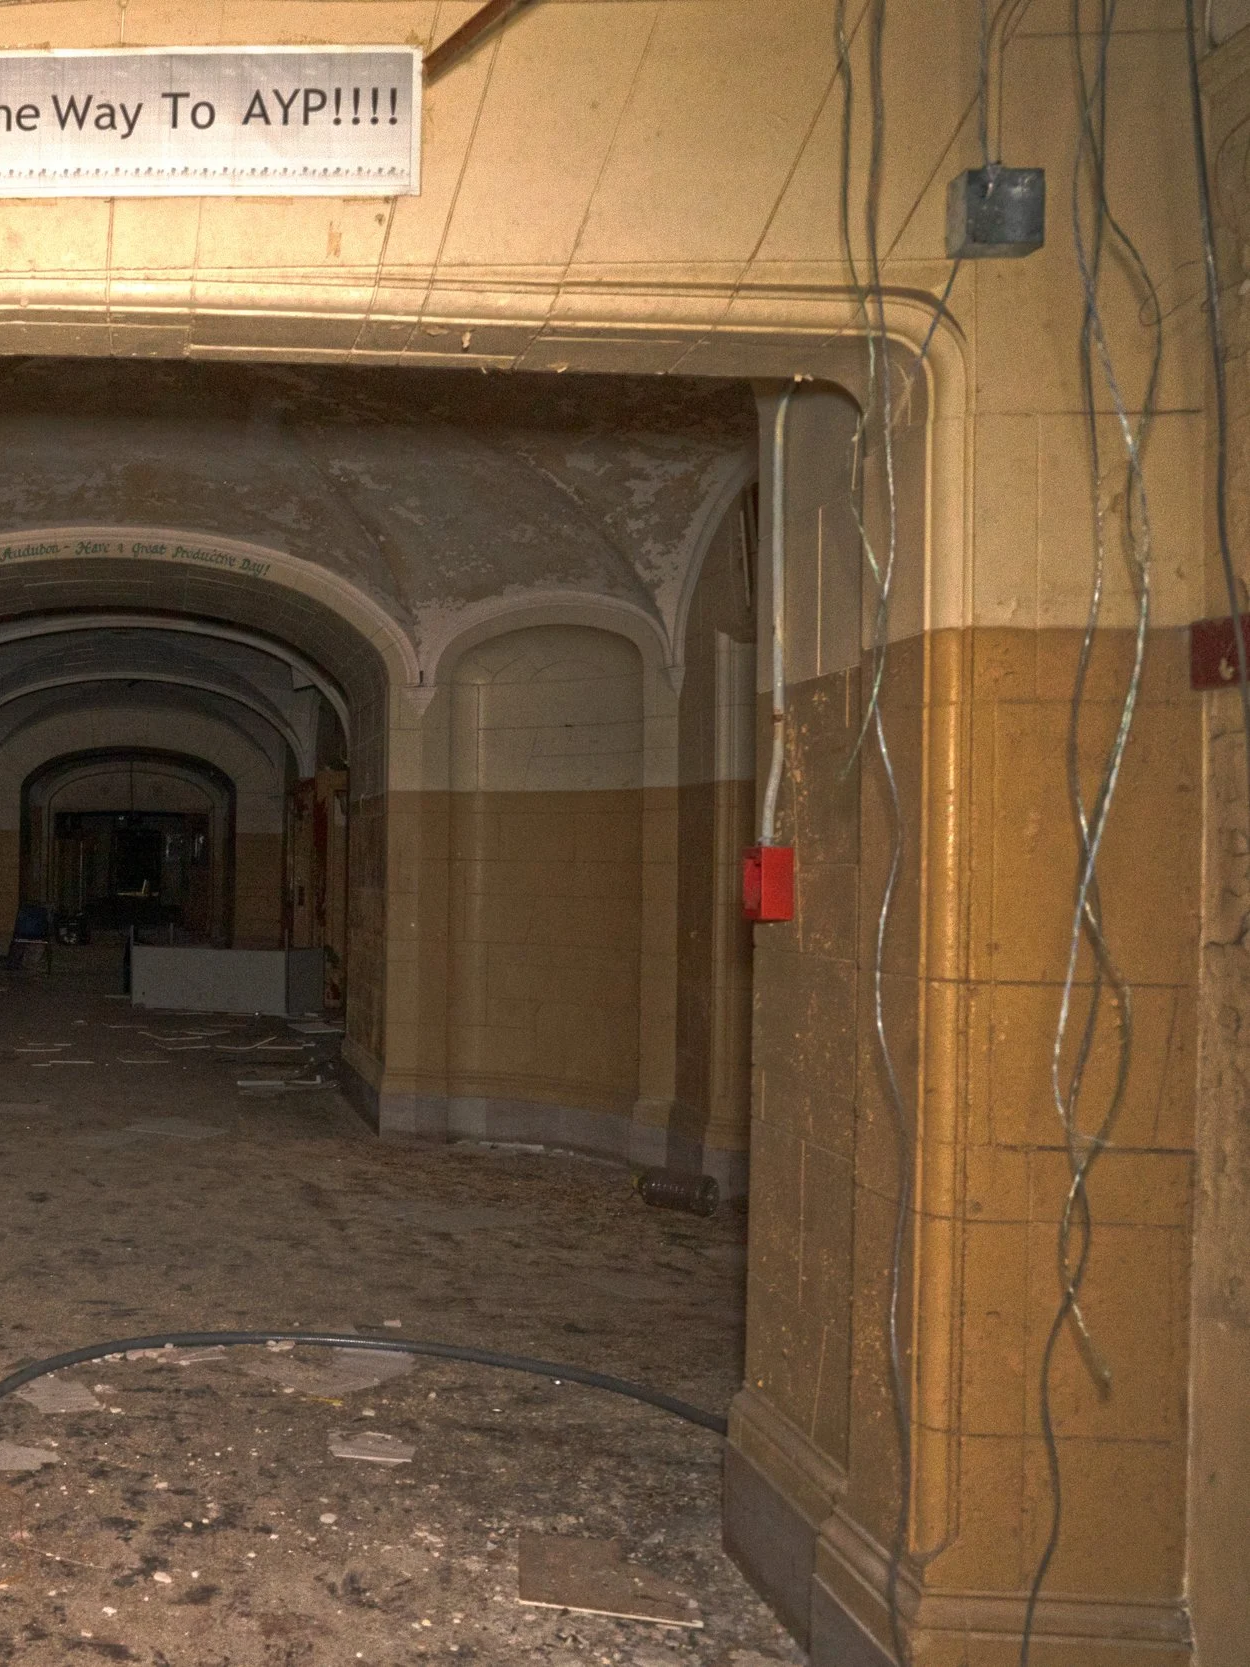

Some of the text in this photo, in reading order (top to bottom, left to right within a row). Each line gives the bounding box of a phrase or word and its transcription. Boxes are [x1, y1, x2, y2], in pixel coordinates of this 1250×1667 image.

[50, 94, 144, 140] Way
[160, 91, 217, 130] To
[241, 87, 399, 126] AYP!!!!
